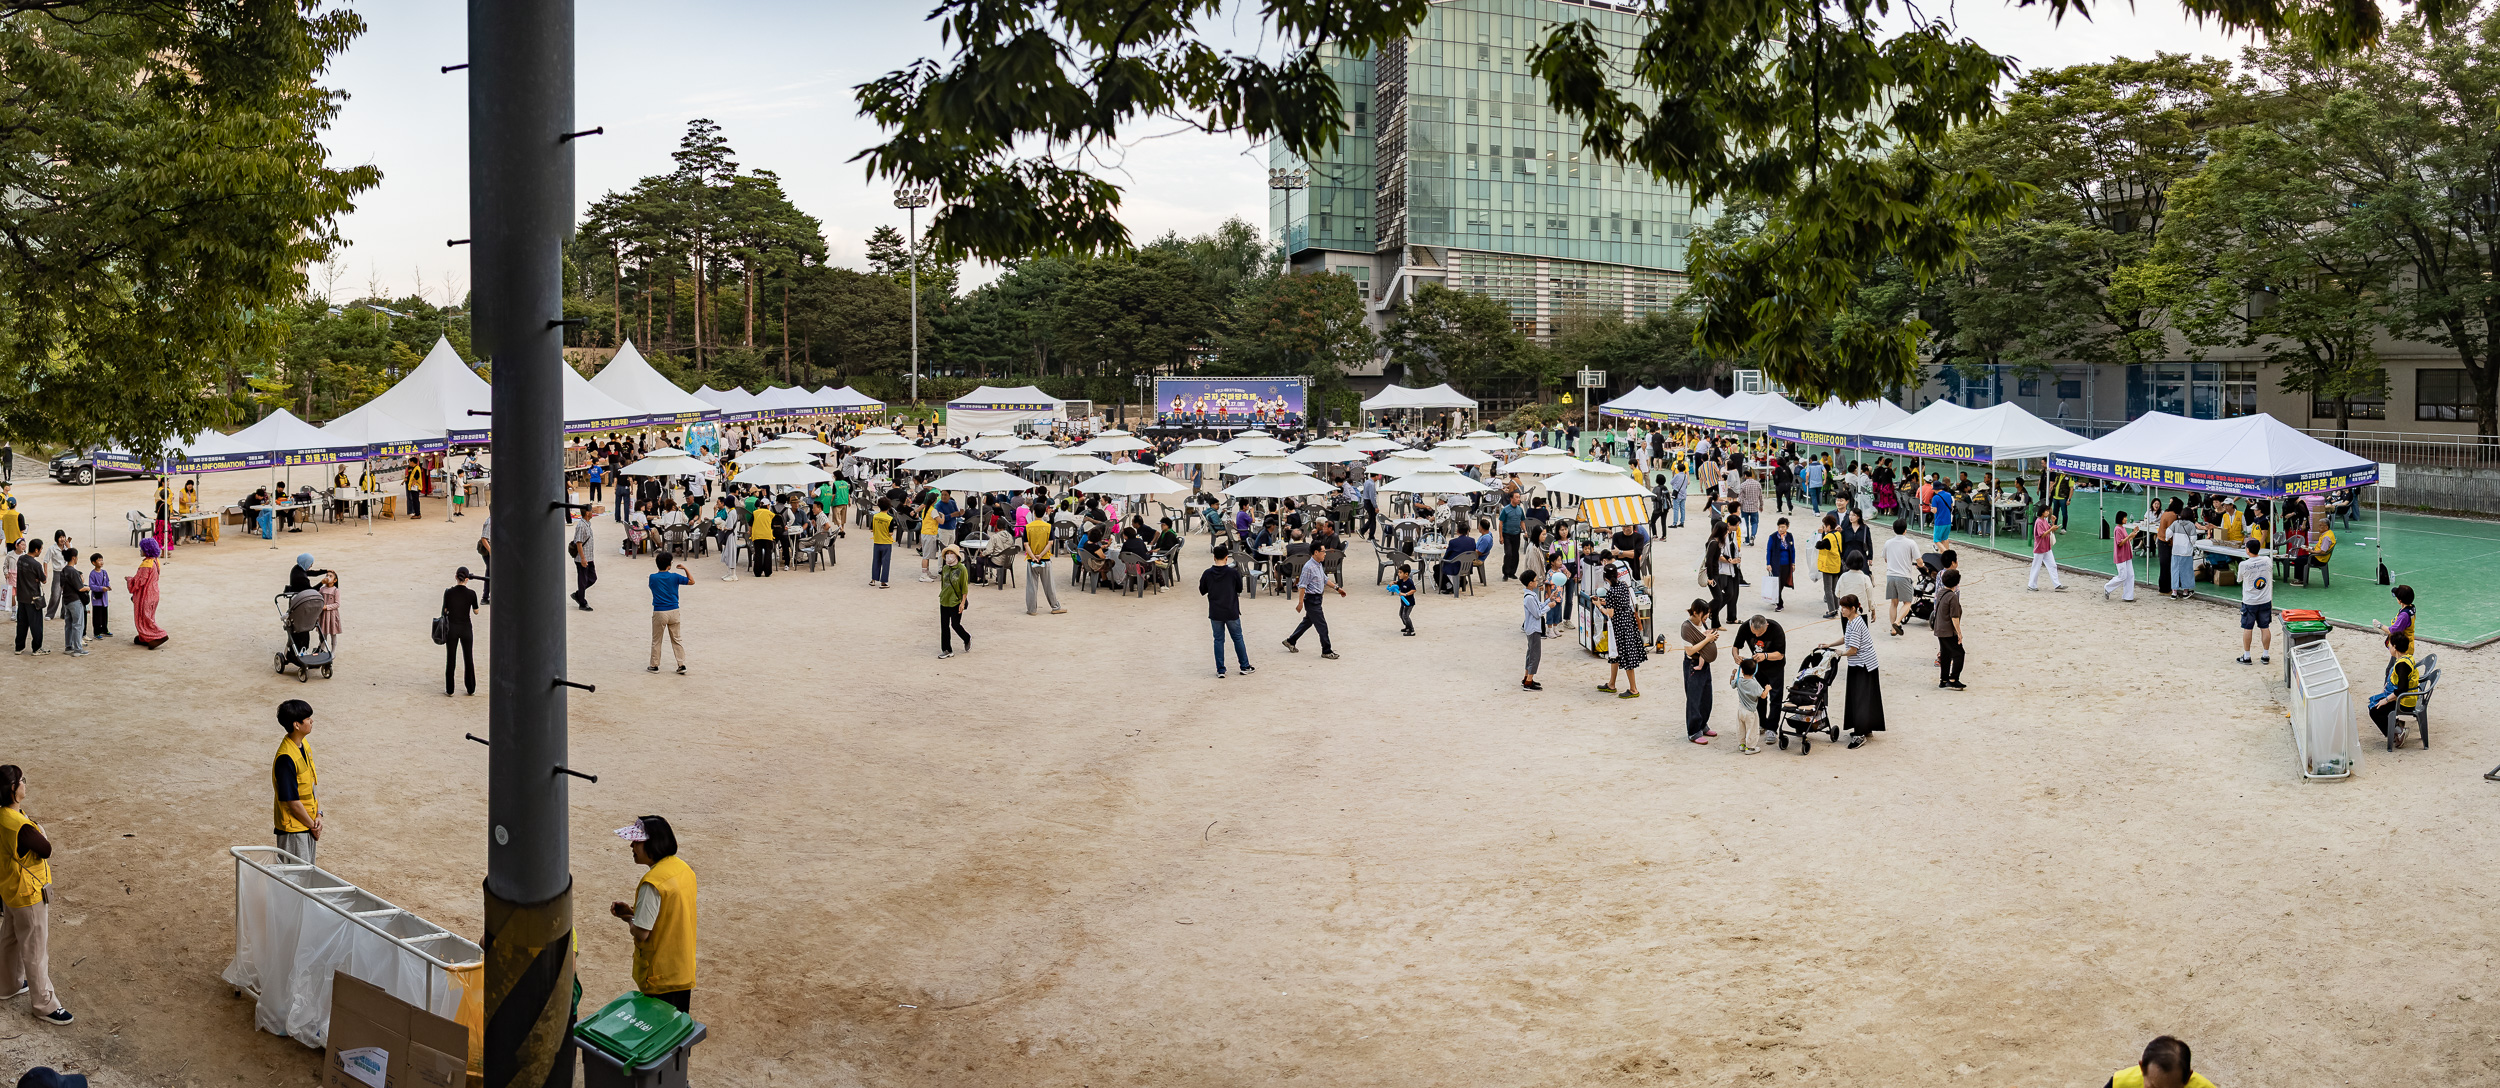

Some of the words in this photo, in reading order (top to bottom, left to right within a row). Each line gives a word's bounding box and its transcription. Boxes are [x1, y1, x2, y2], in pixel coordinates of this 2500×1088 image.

[1800, 431, 1847, 446] 먹거리장터(FOOD)
[285, 455, 302, 464] 응급
[306, 452, 337, 463] 의료지원
[380, 446, 394, 455] 복지
[398, 444, 419, 454] 상담소
[1907, 440, 1975, 459] 먹거리장터(FOOD)
[2055, 458, 2067, 468] 2025
[2068, 460, 2080, 470] 군자
[2080, 462, 2109, 474] 한마당축제
[2114, 464, 2160, 482] 먹거리쿠폰
[2164, 470, 2185, 486] 판매
[2285, 478, 2327, 494] 먹거리쿠폰
[2330, 475, 2347, 488] 판매
